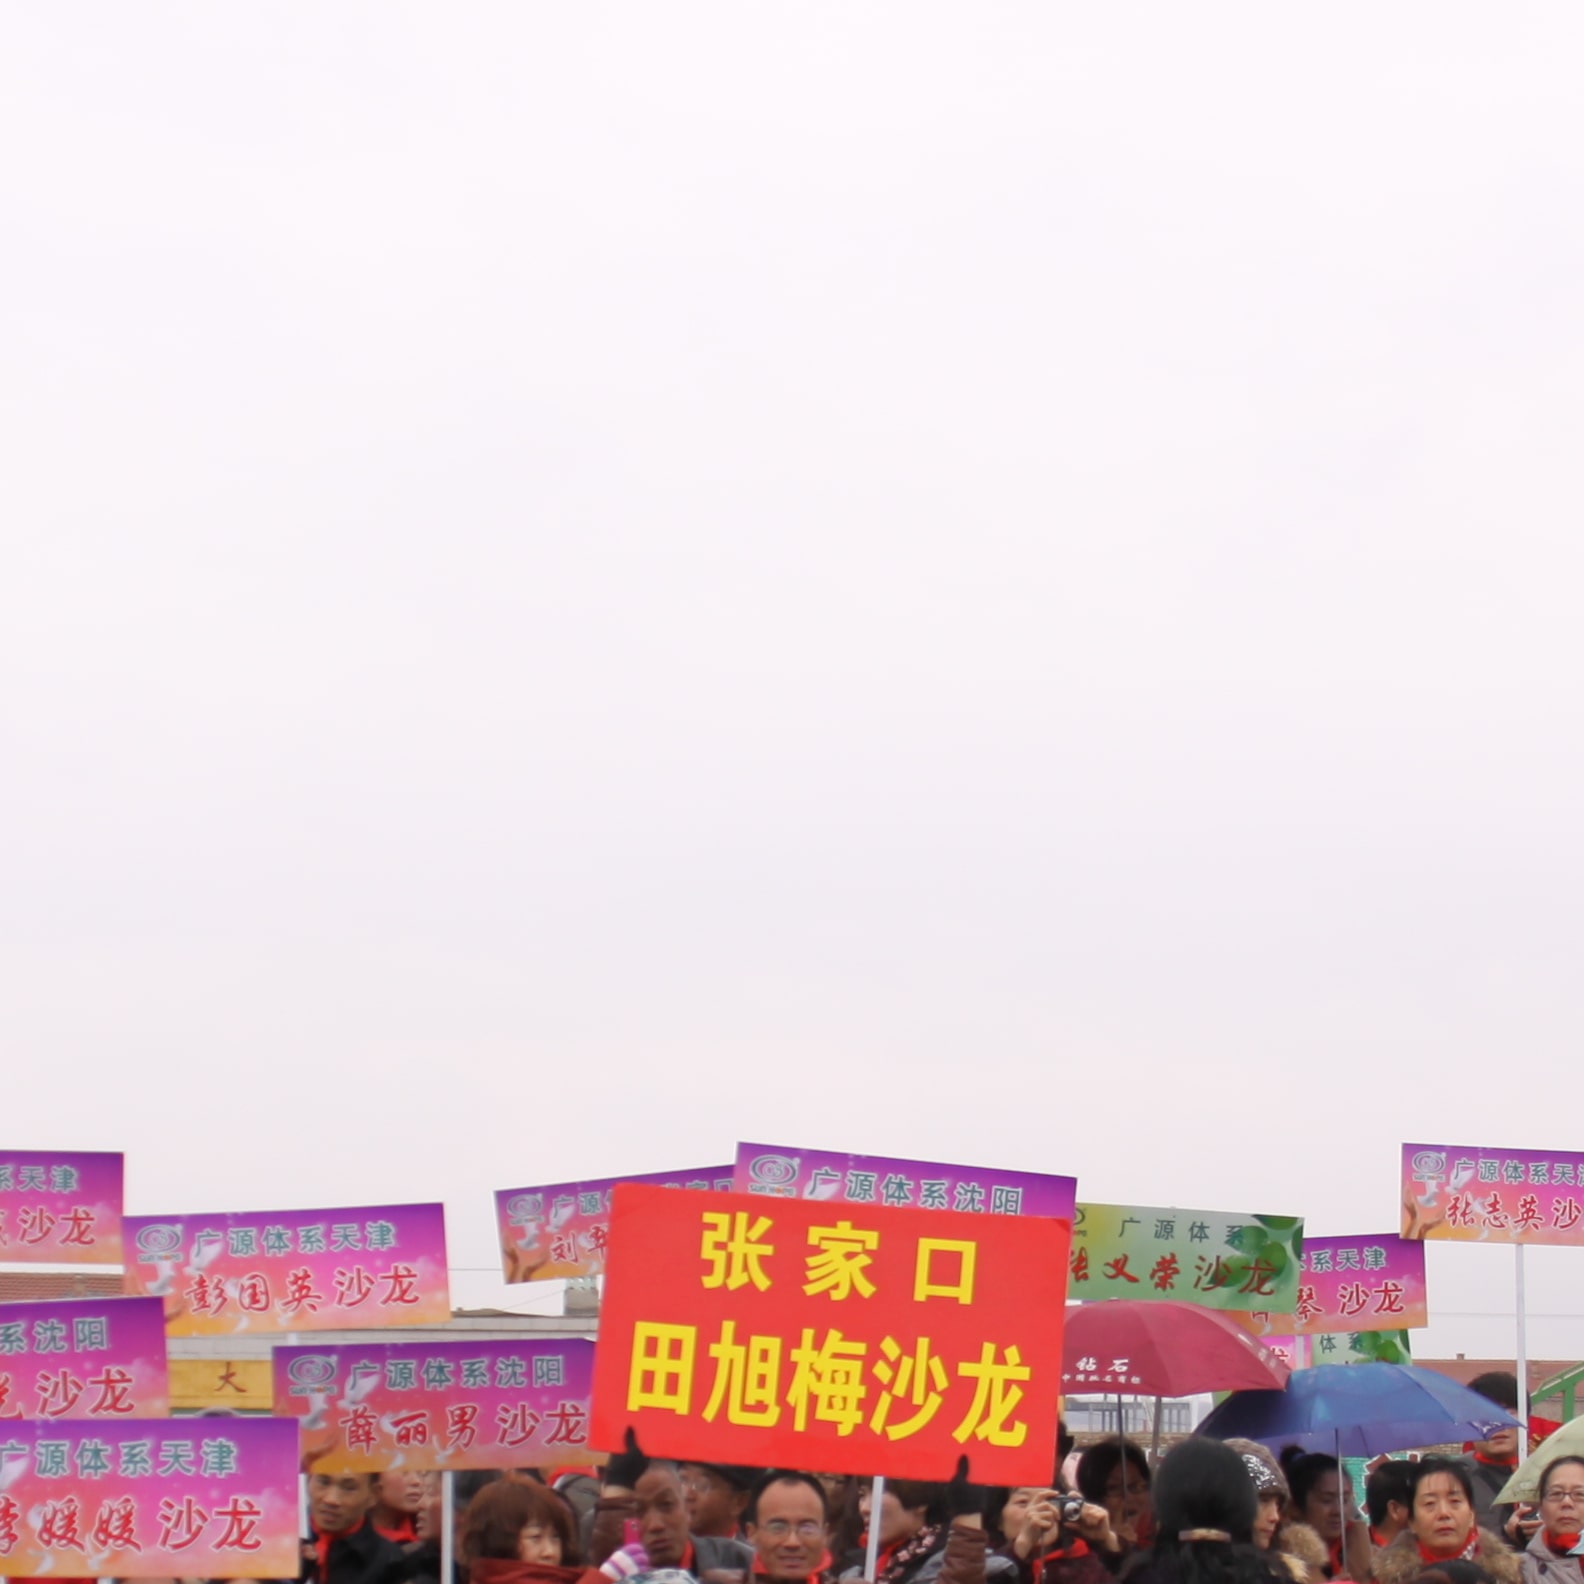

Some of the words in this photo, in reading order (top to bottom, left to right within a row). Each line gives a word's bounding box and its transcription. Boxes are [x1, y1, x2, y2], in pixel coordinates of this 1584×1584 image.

[807, 1167, 1024, 1216] 广源体系沈阳
[194, 1221, 396, 1259] 广源体系天津
[1118, 1217, 1246, 1246] 广源体系
[699, 1211, 977, 1305] 张家口
[1299, 1246, 1388, 1274] 系天津
[348, 1354, 565, 1392] 广源体系沈阳
[626, 1319, 1031, 1448] 田旭梅沙龙
